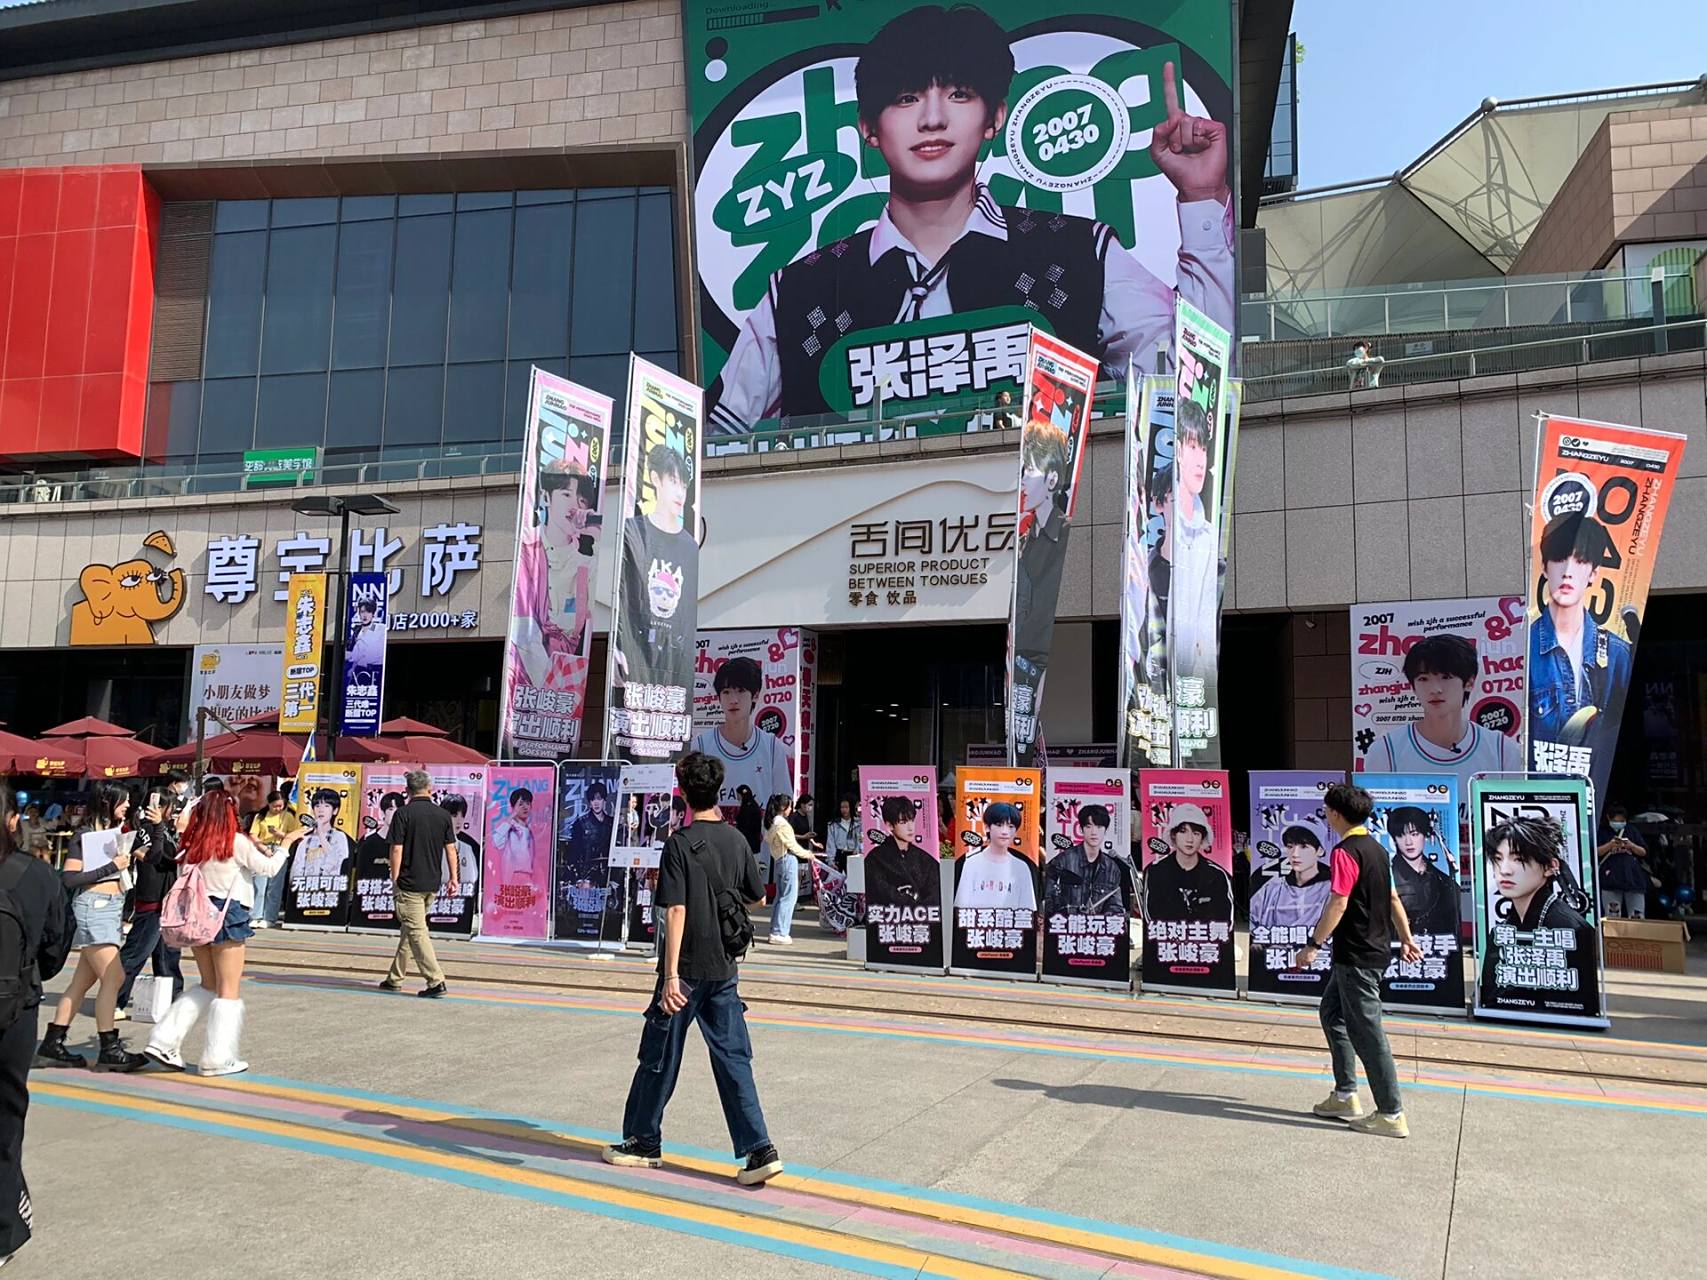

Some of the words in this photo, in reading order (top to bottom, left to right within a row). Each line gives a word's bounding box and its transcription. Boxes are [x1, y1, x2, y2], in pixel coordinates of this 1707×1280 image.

[1032, 103, 1093, 144] 2007
[1038, 123, 1100, 161] 0430
[736, 158, 834, 227] ZYZ
[848, 322, 1030, 406] 张泽禹
[1552, 491, 1583, 506] 2007
[1628, 477, 1654, 556] ZHANGZEYU
[849, 561, 916, 575] SUPERIOR
[920, 557, 990, 572] PRODUCT
[848, 576, 915, 590] BETWEEN
[920, 572, 988, 587] TONGUES
[848, 591, 879, 607] 零食
[886, 590, 917, 606] 饮品
[1362, 612, 1395, 627] 2007
[1407, 618, 1426, 627] wish
[1446, 611, 1486, 623] successful
[1423, 620, 1473, 634] performance
[284, 682, 316, 700] 三代
[765, 674, 796, 689] hao
[204, 684, 271, 700] 小朋友做梦
[513, 684, 576, 715] 张峻豪
[624, 681, 688, 713] 张峻豪
[764, 691, 793, 705] 0720
[283, 700, 316, 718] 第一
[1480, 708, 1506, 723] 2007
[610, 705, 692, 742] 演出顺利
[868, 905, 941, 923] 实力ACE
[958, 908, 1033, 929] 甜系酷盖
[878, 924, 931, 944] 张峻豪
[1049, 914, 1126, 936] 全能玩家
[1148, 921, 1230, 942] 绝对主舞
[967, 929, 1024, 949] 张峻豪
[1058, 935, 1116, 957] 张峻豪
[1495, 926, 1577, 949] 第一主唱
[1158, 942, 1220, 963] 张峻豪
[1506, 948, 1566, 969] 张泽禹
[1497, 966, 1578, 990] 演出顺利
[1497, 997, 1536, 1007] ZHANGZEYU
